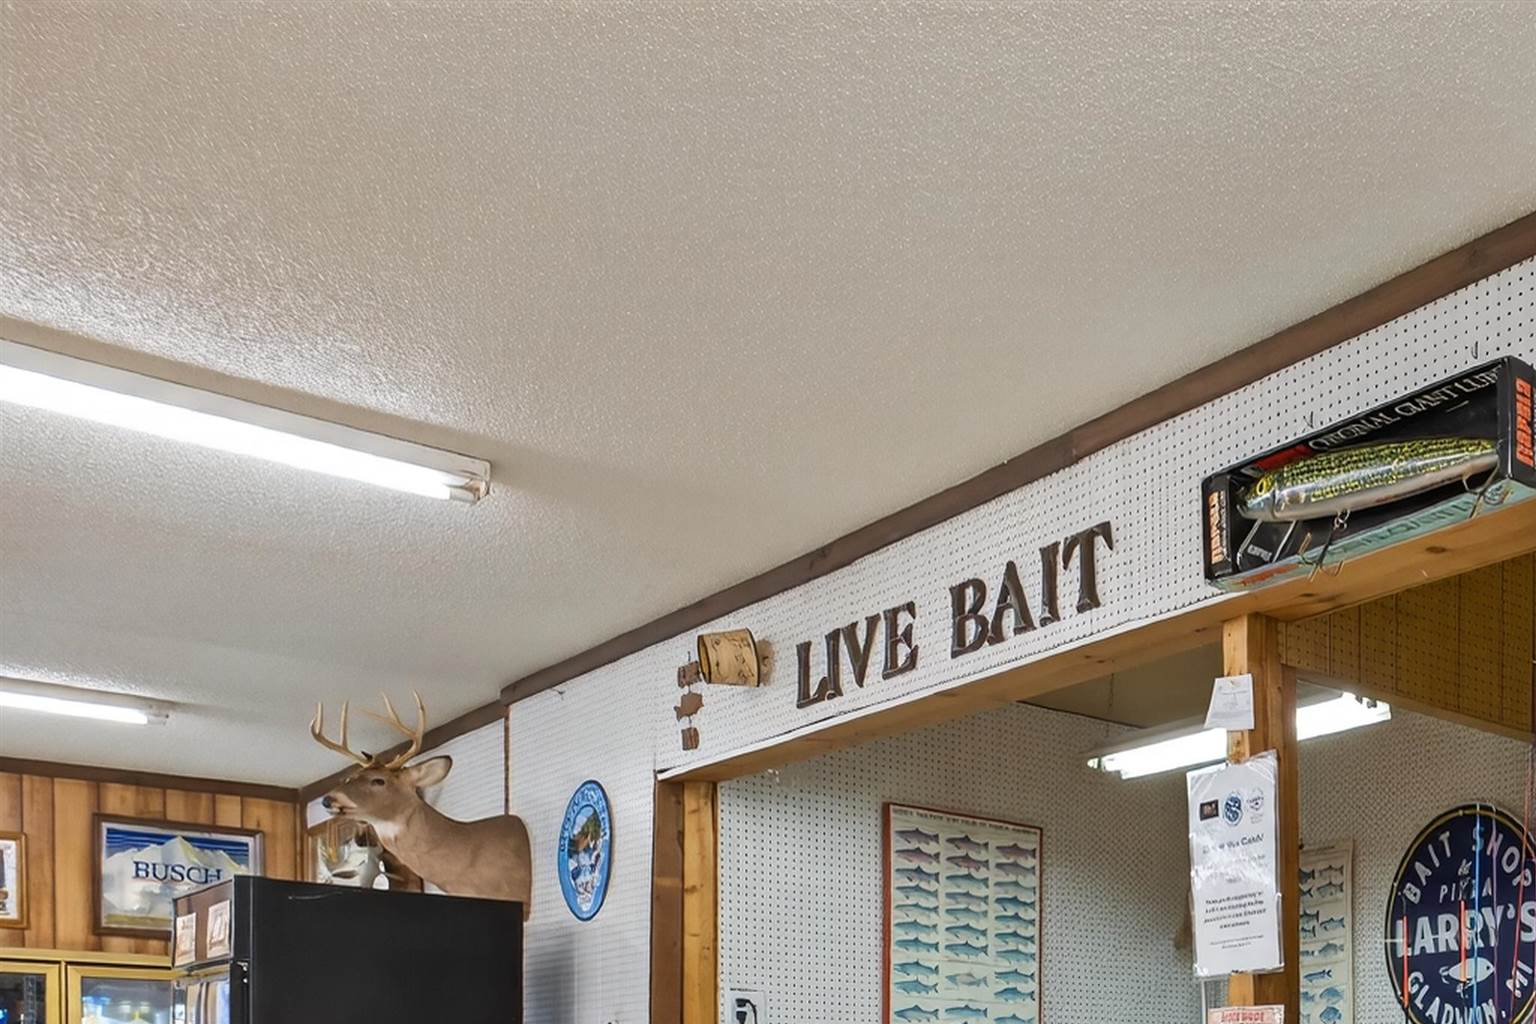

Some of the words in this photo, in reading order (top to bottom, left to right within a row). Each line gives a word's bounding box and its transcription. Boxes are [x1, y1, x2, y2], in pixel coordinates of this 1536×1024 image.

[1394, 385, 1457, 417] GIANT
[795, 600, 920, 709] LIVE
[948, 519, 1115, 660] BAIT
[132, 860, 222, 885] BUSCH
[1403, 831, 1451, 904] BAIT
[1472, 825, 1533, 888] SHOP
[1506, 959, 1534, 999] MI
